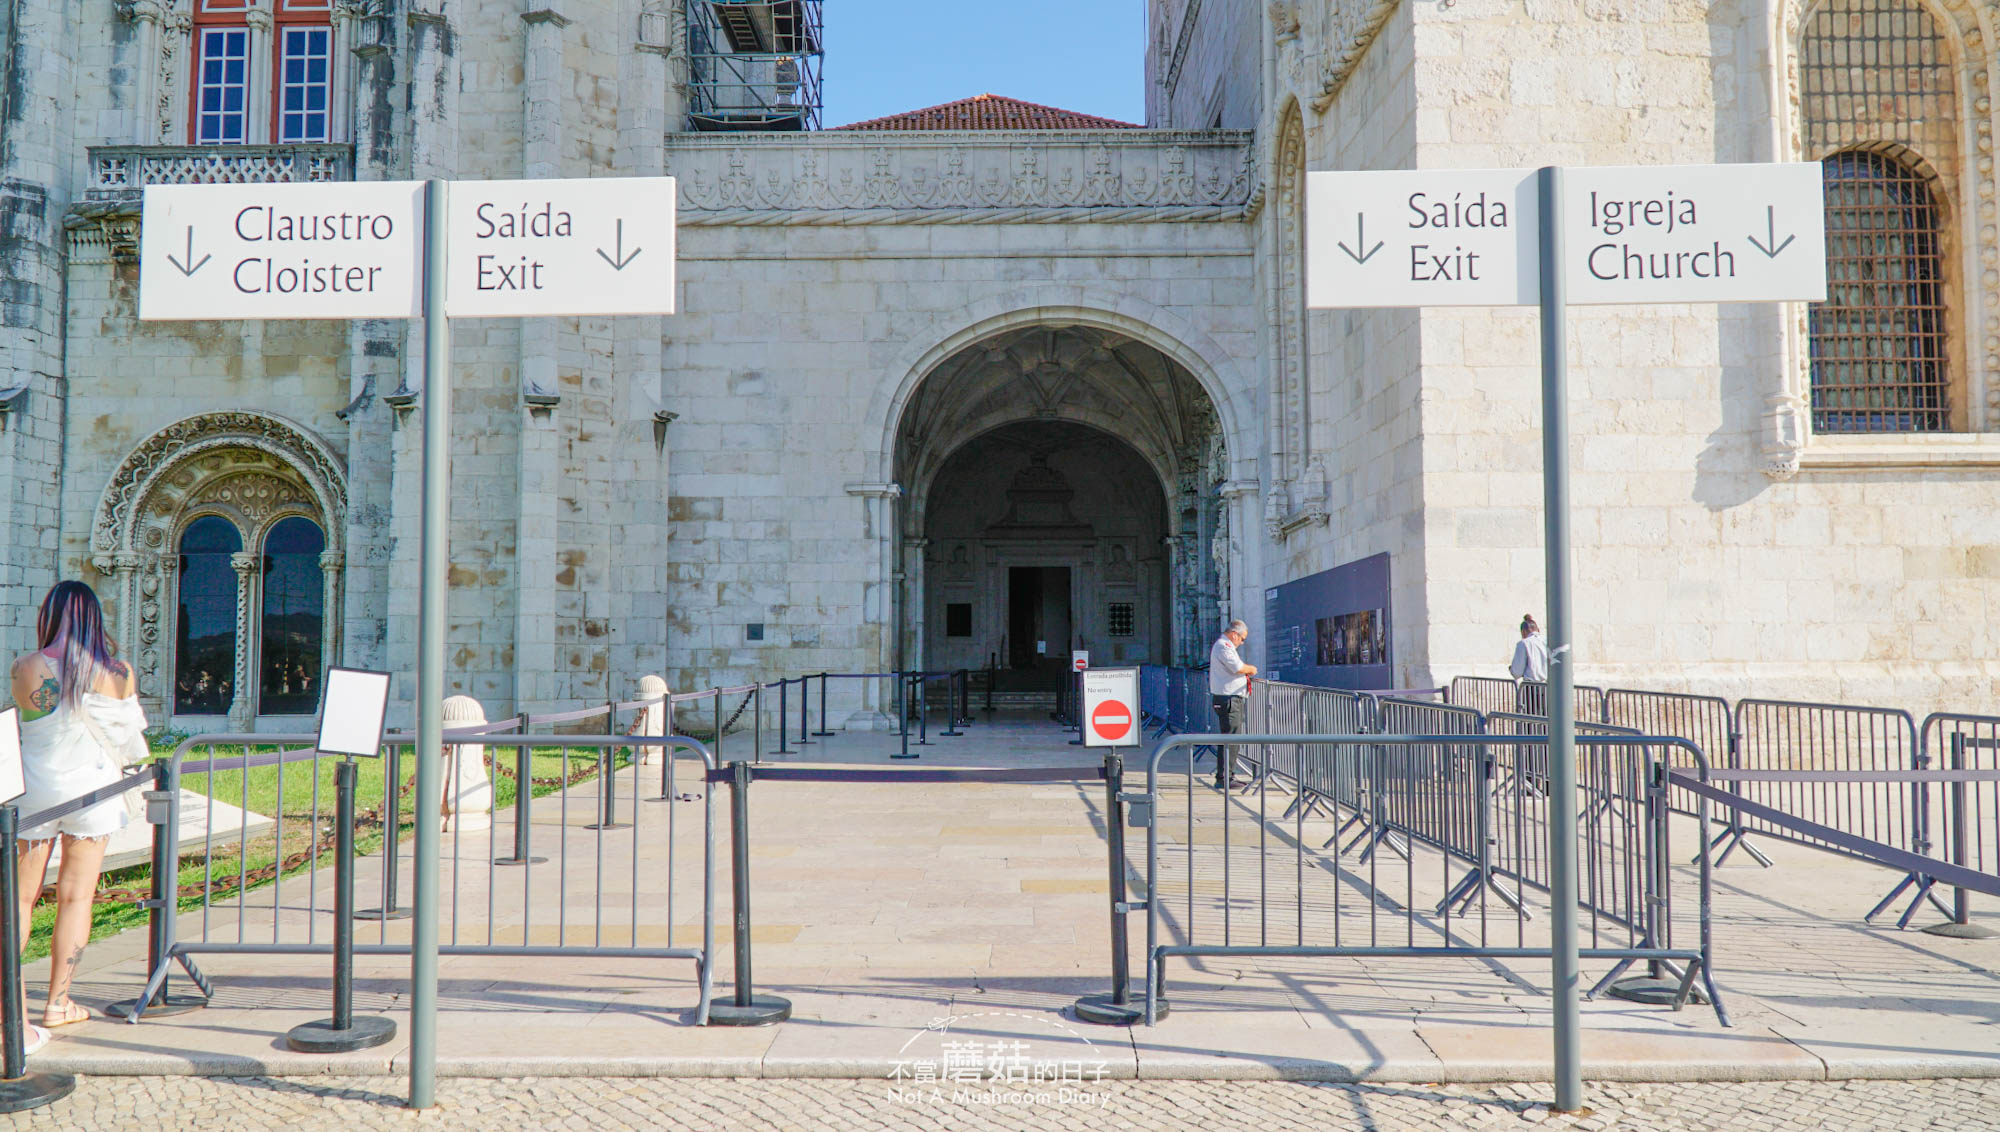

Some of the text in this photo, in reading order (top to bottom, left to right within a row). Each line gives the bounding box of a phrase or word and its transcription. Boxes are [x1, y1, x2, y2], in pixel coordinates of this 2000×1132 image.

[235, 205, 393, 241] Claustro
[476, 202, 572, 238] Saída
[1408, 192, 1508, 228] Saída
[1590, 191, 1697, 235] Igreja
[233, 257, 382, 293] Cloister
[476, 254, 544, 290] Exit
[1410, 245, 1480, 281] Exit
[1588, 241, 1735, 280] Church
[1108, 671, 1132, 679] proibida
